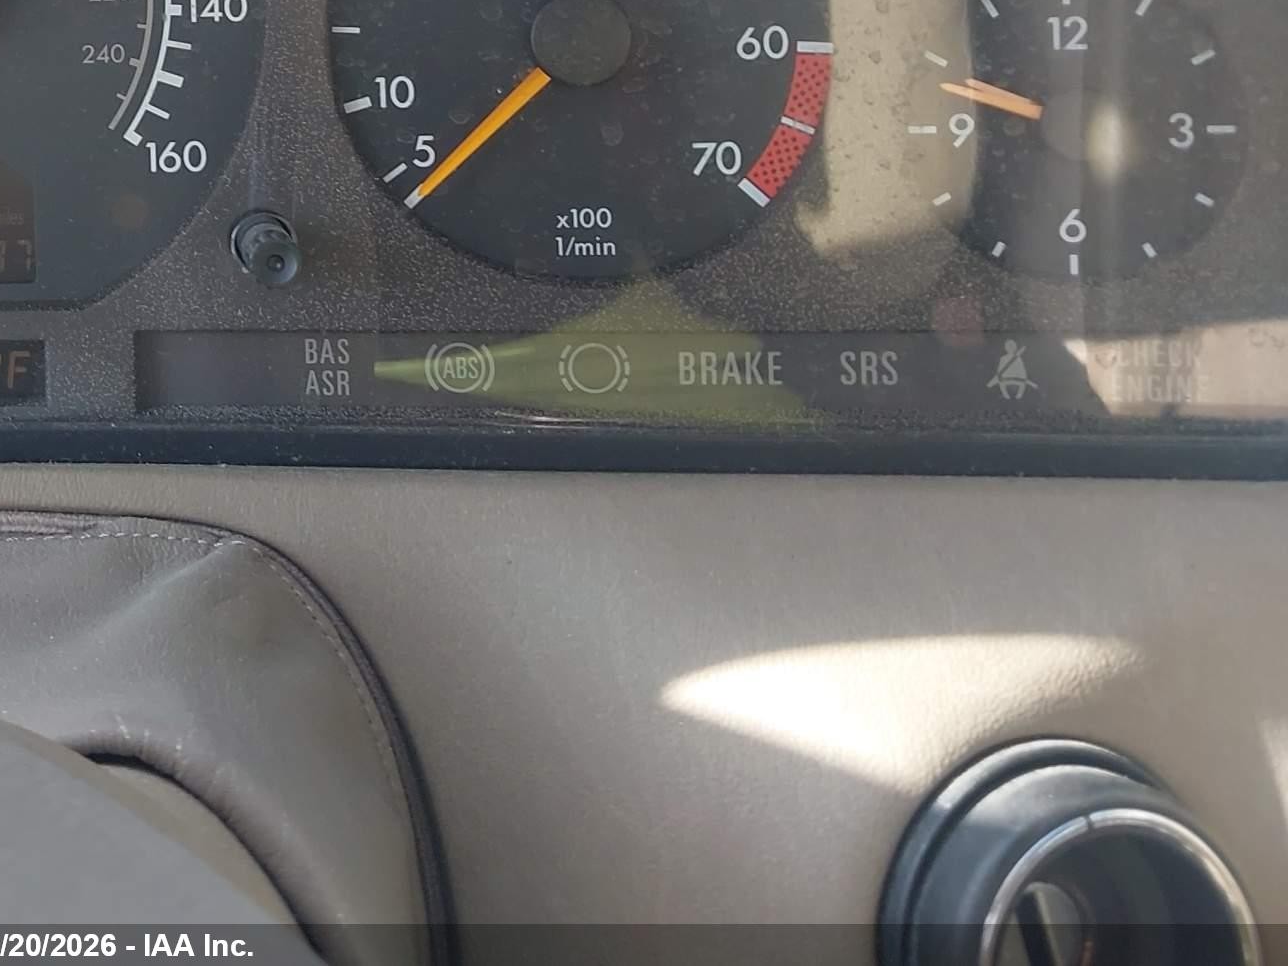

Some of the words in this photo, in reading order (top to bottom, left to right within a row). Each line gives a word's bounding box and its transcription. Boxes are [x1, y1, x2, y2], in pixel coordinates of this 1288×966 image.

[736, 25, 789, 60] 60
[1047, 16, 1088, 50] 12
[81, 43, 125, 63] 240
[374, 75, 415, 109] 10
[949, 113, 975, 148] 9
[1168, 112, 1194, 149] 3
[146, 140, 207, 173] 160
[413, 135, 436, 168] 5
[692, 141, 742, 175] 70
[556, 208, 612, 229] x100
[1059, 209, 1087, 244] 6
[555, 237, 616, 258] 1/min
[305, 338, 350, 365] BAS
[841, 351, 898, 385] SRS
[305, 370, 351, 397] ASR
[443, 357, 479, 380] ABS
[678, 352, 782, 385] BRAKE
